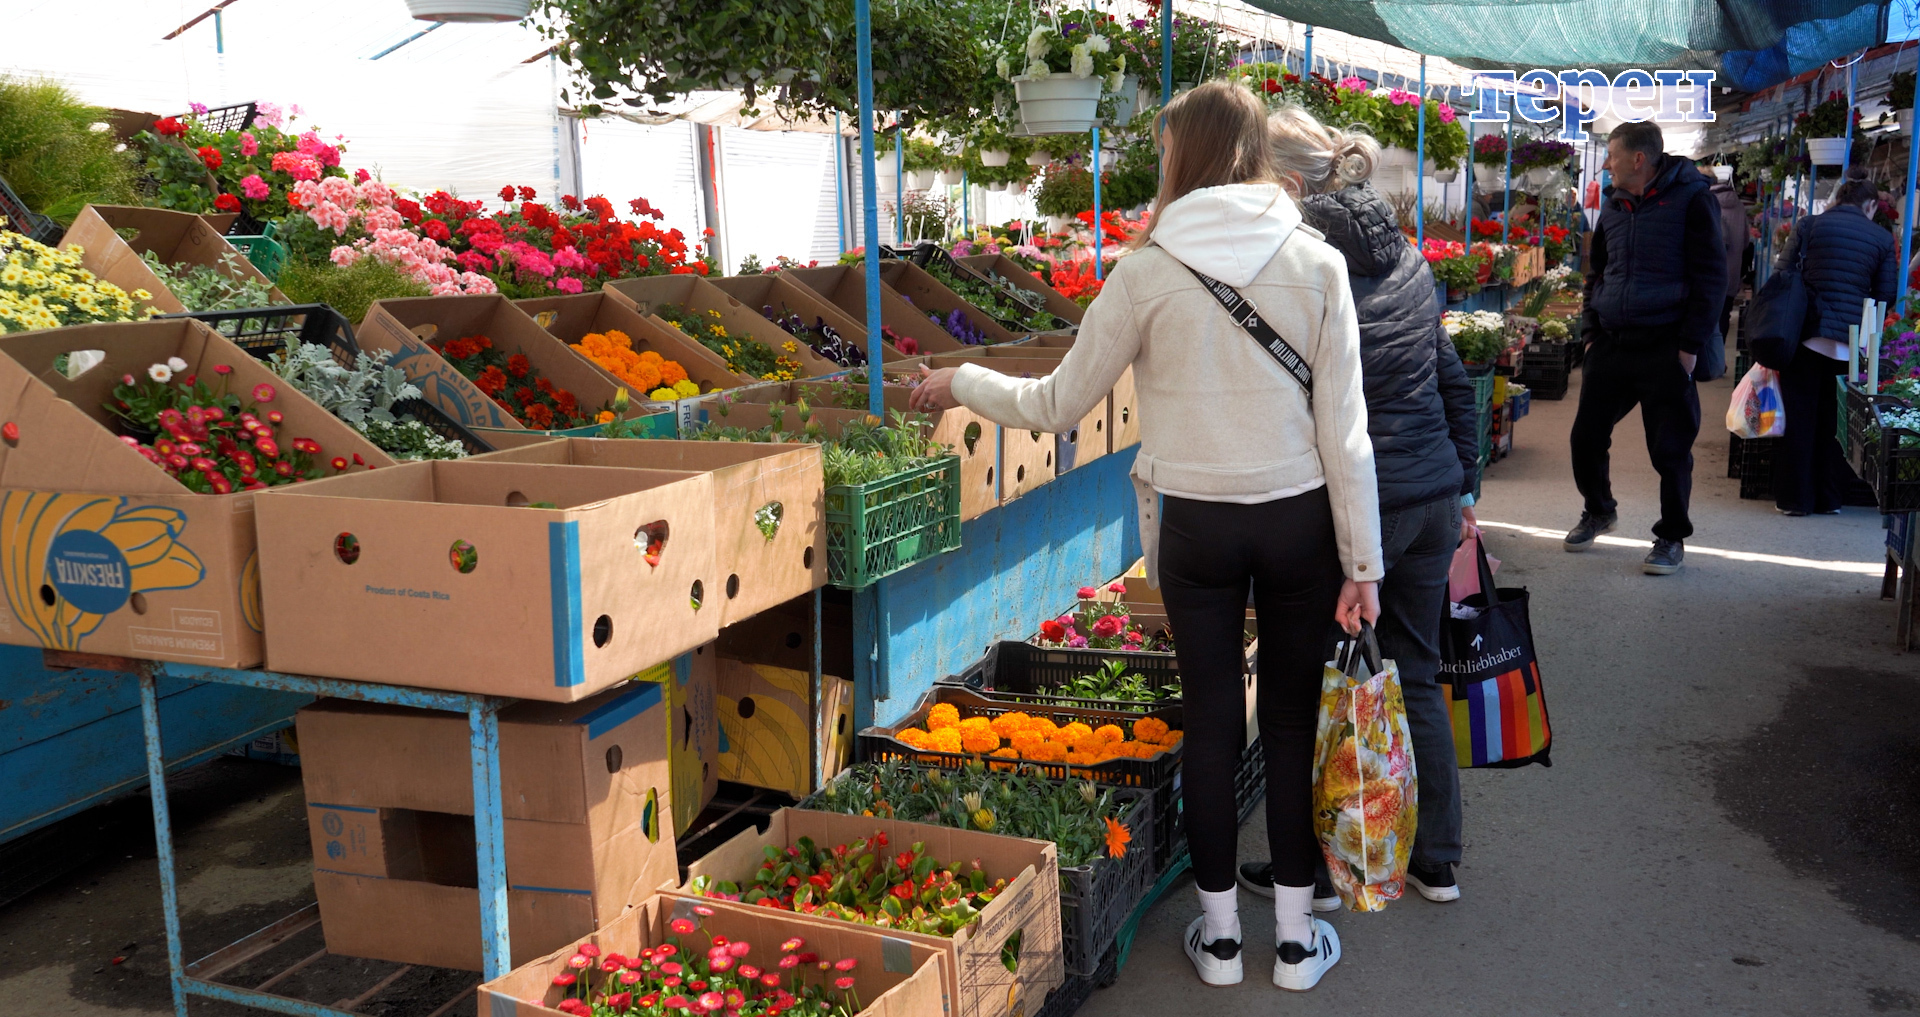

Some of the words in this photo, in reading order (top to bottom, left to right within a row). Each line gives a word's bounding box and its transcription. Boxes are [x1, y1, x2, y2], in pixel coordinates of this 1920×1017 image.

[1214, 283, 1238, 307] LOUIS
[1269, 338, 1299, 371] VUITTON
[1294, 362, 1311, 384] LOUIS
[54, 556, 125, 589] FRESKITA
[365, 584, 396, 596] Product
[398, 588, 406, 596] of
[407, 588, 431, 599] Costa
[432, 590, 450, 601] Rica
[178, 615, 214, 628] ECUADOR
[135, 633, 176, 648] BANANAS
[175, 637, 216, 652] PREMIUM
[985, 915, 1008, 942] PRODUCT
[1007, 908, 1014, 921] OF
[1014, 888, 1034, 915] ECUADOR
